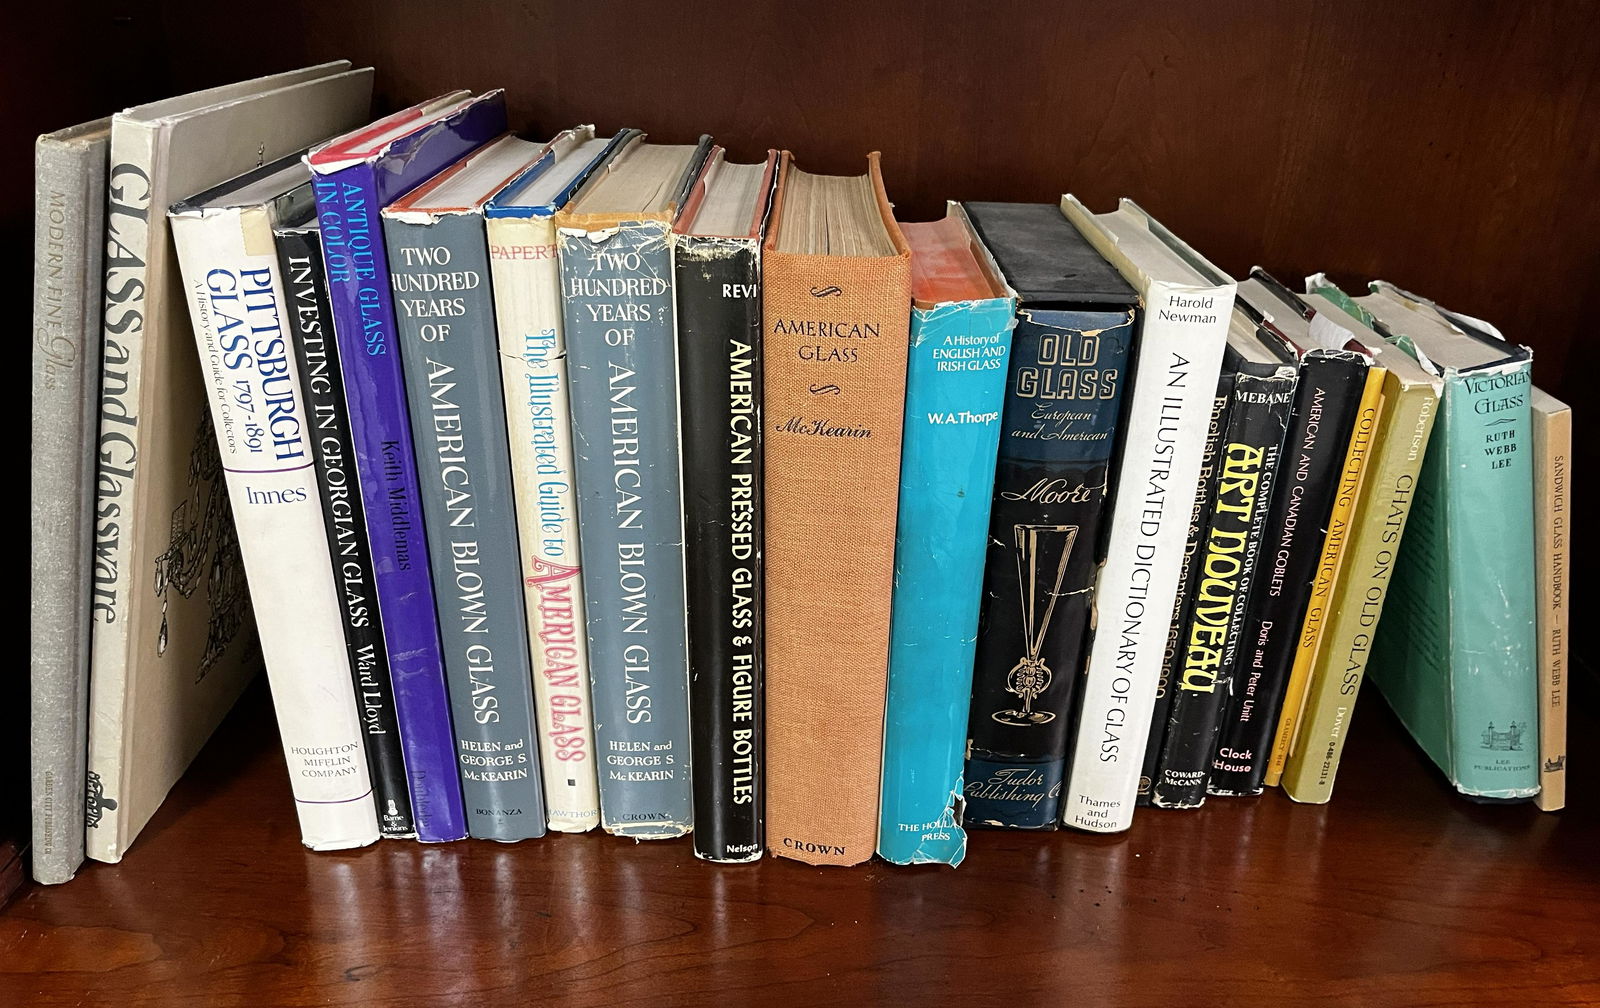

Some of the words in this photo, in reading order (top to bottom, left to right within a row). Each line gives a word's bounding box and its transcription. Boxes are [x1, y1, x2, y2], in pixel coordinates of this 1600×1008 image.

[316, 182, 338, 204] IN
[47, 190, 65, 280] MODERN
[342, 182, 376, 281] ANTIQUE
[105, 163, 151, 335] GLASS
[322, 212, 350, 284] COLOR
[400, 246, 451, 266] TWO
[490, 243, 558, 260] PAPERT
[590, 252, 641, 271] TWO
[194, 279, 204, 288] A
[571, 278, 668, 297] HUNDRED
[722, 284, 757, 298] REVI
[46, 286, 62, 329] FINE
[196, 291, 211, 333] History
[400, 298, 466, 317] YEARS
[585, 304, 651, 322] YEARS
[1158, 309, 1217, 324] Newman
[1169, 296, 1213, 309] Harold
[206, 268, 253, 370] GLASS
[288, 256, 331, 394] INVESTING
[358, 288, 387, 356] GLASS
[773, 318, 880, 339] AMERICAN
[204, 332, 217, 353] and
[420, 324, 451, 343] OF
[604, 328, 636, 346] OF
[943, 335, 953, 345] A
[954, 335, 988, 347] History
[988, 332, 1000, 343] of
[525, 328, 557, 369] The
[798, 345, 858, 363] GLASS
[933, 347, 981, 359] ENGLISH
[981, 345, 1006, 358] AND
[1037, 334, 1100, 367] OLD
[209, 354, 224, 386] Guide
[240, 266, 304, 461] PITTSBURGH
[937, 361, 966, 372] IRISH
[967, 359, 1001, 371] GLASS
[1166, 352, 1190, 388] AN
[102, 339, 138, 427] and
[217, 388, 227, 402] for
[1015, 367, 1118, 400] GLASS
[729, 338, 752, 465] AMERICAN
[1235, 390, 1291, 405] MEBANE
[1474, 394, 1524, 415] GLASS
[316, 405, 338, 431] IN
[525, 372, 566, 476] Illustrated
[776, 416, 872, 439] McKearin
[1031, 402, 1092, 428] European
[1304, 387, 1326, 450] AMERICAN
[1407, 397, 1433, 461] Robertson
[220, 404, 237, 455] Collectors
[426, 357, 474, 528] AMERICAN
[1011, 424, 1045, 439] and
[1040, 421, 1108, 440] American
[1486, 430, 1515, 443] RUTH
[608, 360, 643, 530] AMERICAN
[1264, 444, 1279, 470] THE
[1339, 408, 1375, 507] COLLECTING
[1484, 443, 1517, 456] WEBB
[381, 440, 400, 481] Keith
[1140, 397, 1181, 537] ILLUSTRATED
[1296, 454, 1310, 481] AND
[1491, 458, 1512, 470] LEE
[246, 486, 307, 504] Innes
[1001, 477, 1098, 504] Moore
[1216, 442, 1265, 522] ART
[1553, 455, 1564, 513] SANDWICH
[321, 436, 359, 557] GEORGIAN
[535, 481, 570, 534] Guide
[1252, 472, 1272, 538] COMPLETE
[1382, 474, 1413, 543] CHATS
[94, 432, 137, 623] Glassware
[388, 486, 411, 571] Middlemas
[730, 473, 753, 560] PRESSED
[1280, 486, 1304, 547] CANADIAN
[543, 535, 566, 557] to
[1553, 517, 1563, 550] GLASS
[1242, 541, 1258, 576] BOOK
[1314, 519, 1345, 598] AMERICAN
[1371, 550, 1392, 580] ON
[451, 540, 488, 634] BLOWN
[1240, 577, 1250, 592] OF
[1270, 550, 1289, 597] GOBLETS
[1552, 552, 1563, 610] HANDBOOK
[343, 561, 369, 629] GLASS
[618, 542, 648, 634] BLOWN
[731, 567, 753, 629] GLASS
[1116, 544, 1155, 674] DICTIONARY
[1359, 586, 1382, 627] OLD
[525, 555, 583, 688] AMERICAN
[1224, 594, 1246, 667] COLLECTING
[1257, 621, 1273, 646] Doris
[1303, 607, 1322, 648] GLASS
[732, 636, 752, 647] &
[1552, 628, 1561, 656] RUTH
[356, 643, 379, 689] Ward
[1252, 649, 1264, 668] and
[1340, 633, 1369, 696] GLASS
[466, 645, 500, 725] GLASS
[623, 645, 652, 725] GLASS
[1246, 672, 1261, 697] Peter
[1551, 659, 1561, 687] WEBB
[732, 654, 753, 722] FIGURE
[1110, 676, 1131, 704] OF
[1551, 689, 1561, 708] LEE
[361, 692, 386, 735] Lloyd
[1331, 706, 1347, 738] Dover
[548, 695, 586, 762] GLASS
[1100, 708, 1126, 763] GLASS
[291, 740, 359, 756] HOUGHTON
[461, 739, 501, 752] HELEN
[504, 738, 523, 751] and
[609, 740, 651, 752] HELEN
[653, 740, 672, 751] and
[1219, 747, 1252, 760] Clock
[301, 765, 358, 778] COMPANY
[304, 756, 351, 767] MIFFLIN
[460, 753, 514, 767] GEORGE
[606, 755, 661, 767] GEORGE
[733, 729, 753, 805] BOTTLES
[1164, 769, 1206, 778] COWARD-
[1217, 760, 1252, 772] House
[988, 768, 1044, 786] Tudor
[1164, 777, 1202, 786] McCANN
[476, 808, 523, 816] BONANZA
[1079, 794, 1121, 809] Thames
[1087, 807, 1109, 818] and
[622, 813, 668, 821] CROWN
[898, 823, 920, 832] THE
[1074, 814, 1117, 829] Hudson
[726, 843, 758, 853] Nelson
[783, 838, 846, 856] CROWN
[921, 833, 950, 842] PRESS
